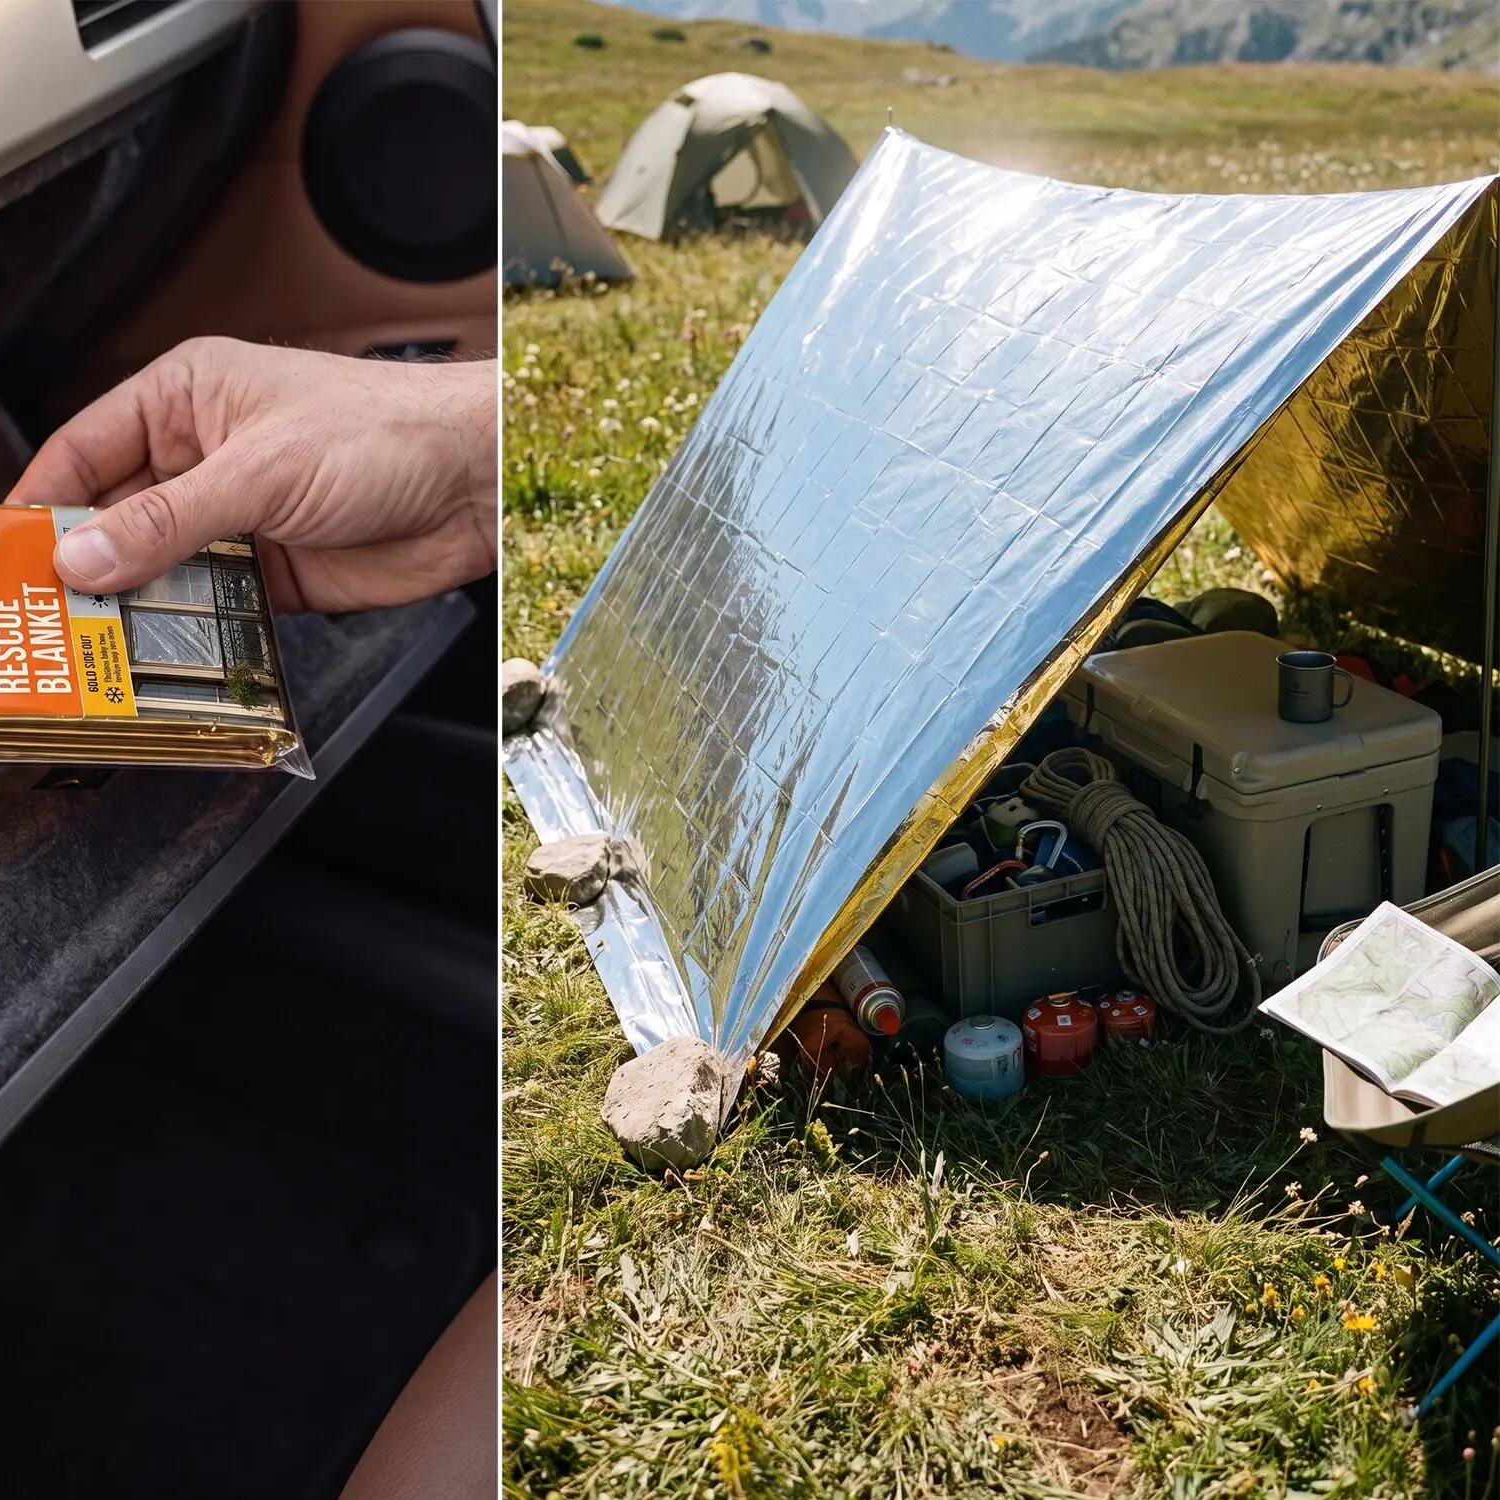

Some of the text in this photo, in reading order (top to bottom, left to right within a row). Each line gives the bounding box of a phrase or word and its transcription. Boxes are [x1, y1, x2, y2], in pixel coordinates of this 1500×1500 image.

[22, 582, 73, 694] BLANKET
[81, 634, 94, 650] OUT
[83, 651, 97, 669] SIDE
